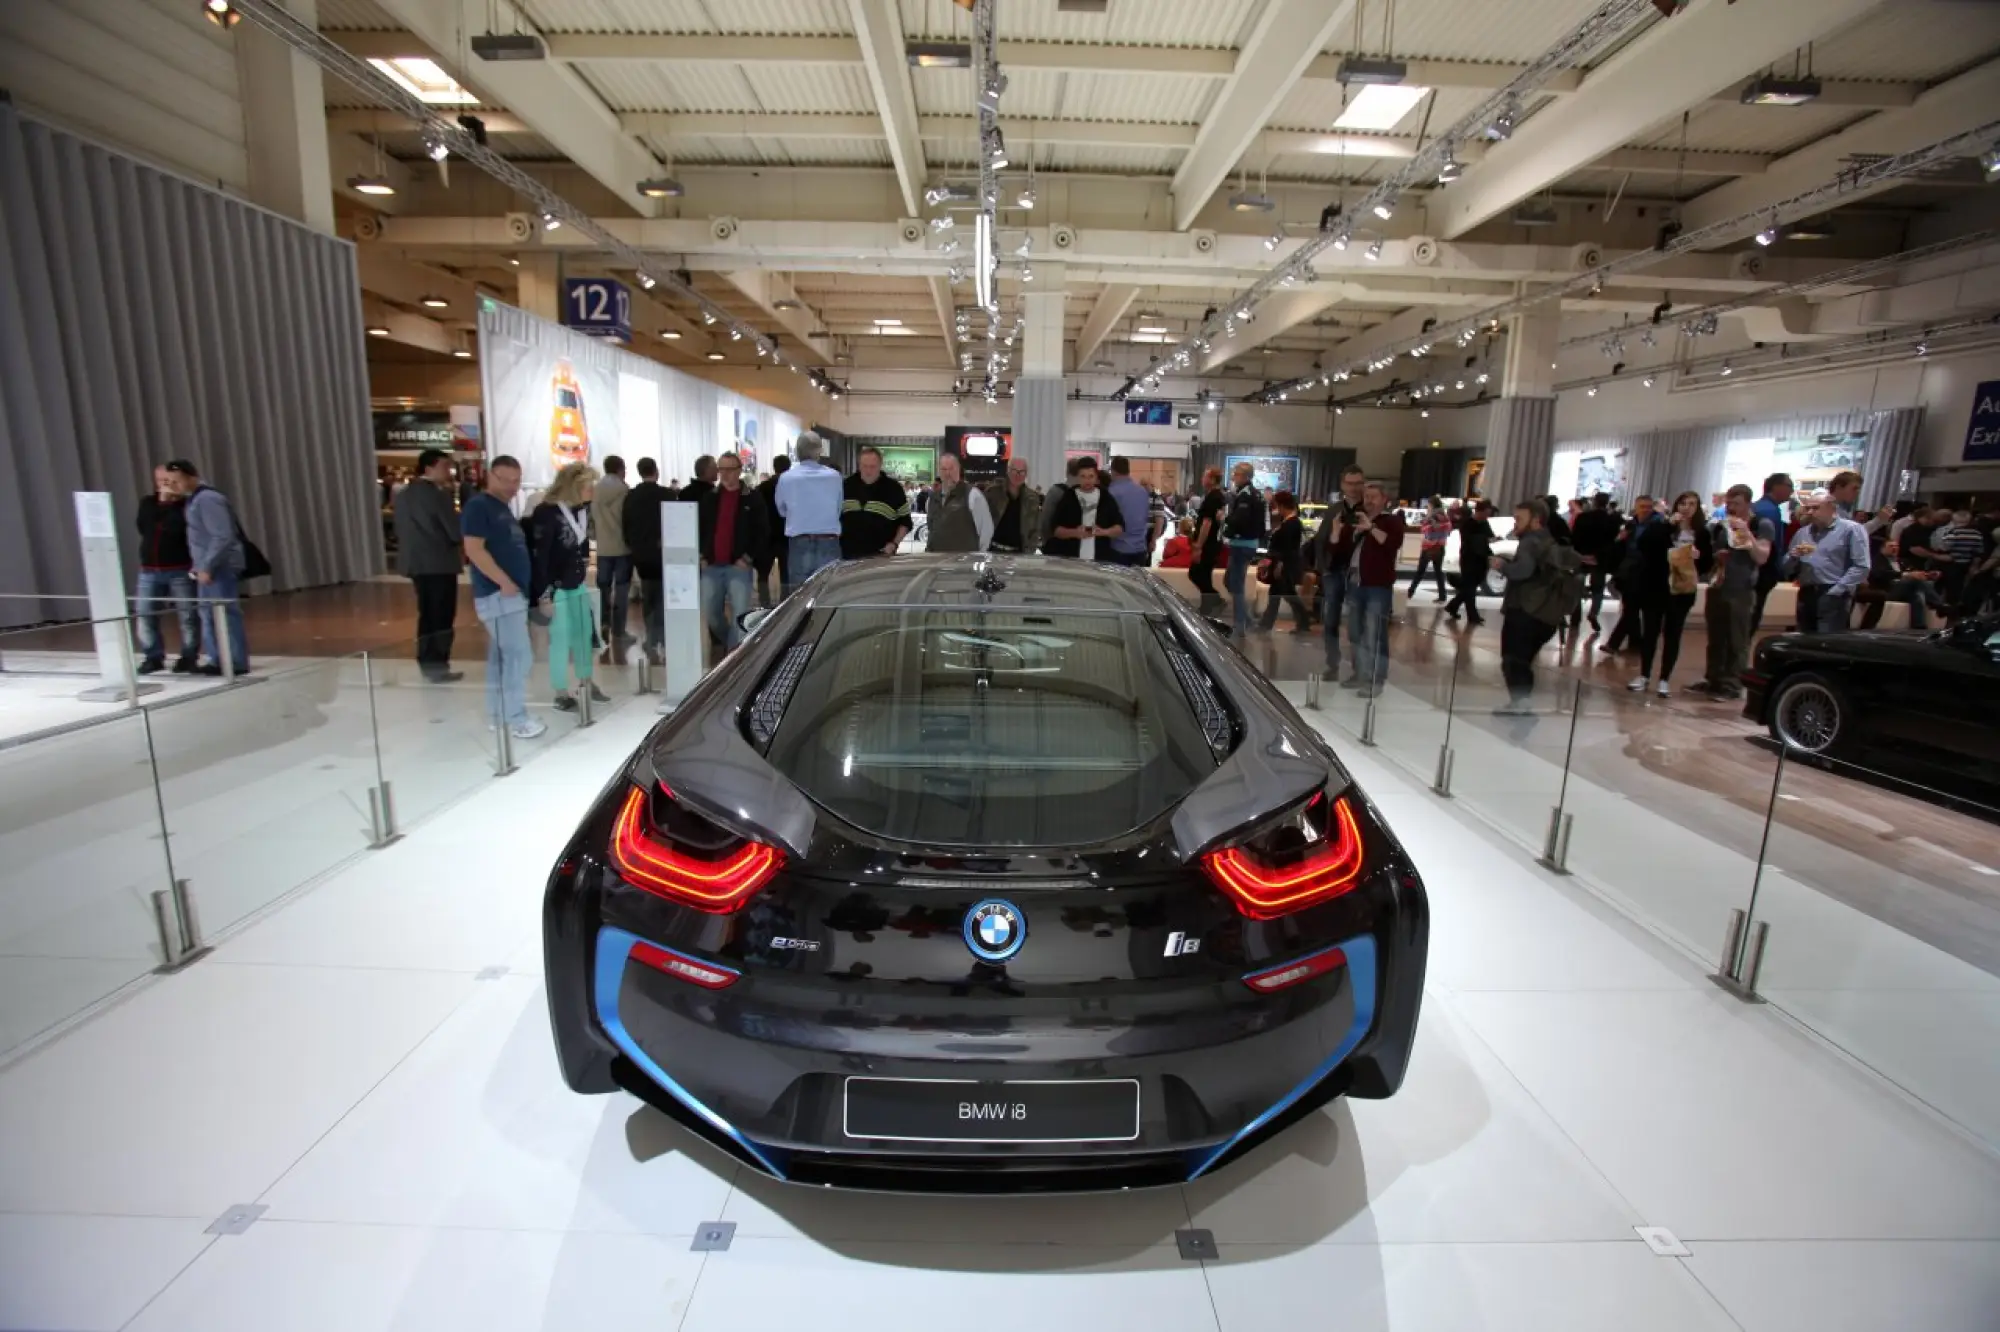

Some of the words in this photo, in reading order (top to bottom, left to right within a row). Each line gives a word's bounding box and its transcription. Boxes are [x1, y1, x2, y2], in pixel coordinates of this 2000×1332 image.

[571, 284, 611, 320] 12
[976, 904, 1016, 921] BMW
[1164, 931, 1200, 957] i8
[959, 1102, 1006, 1119] BMW
[1011, 1103, 1026, 1120] i8
